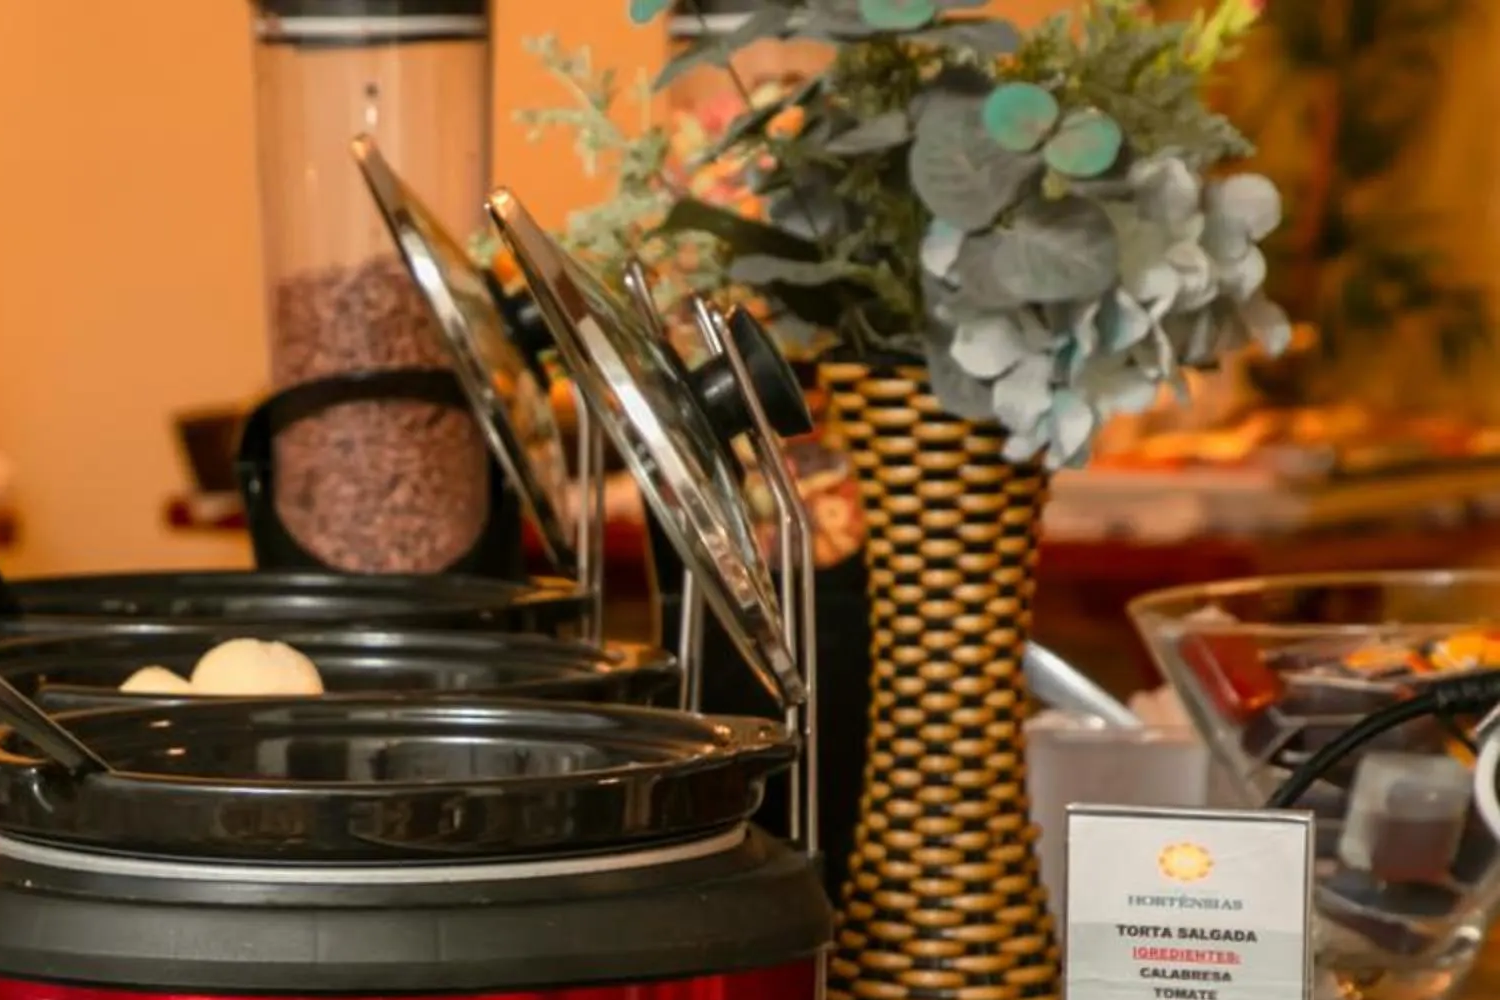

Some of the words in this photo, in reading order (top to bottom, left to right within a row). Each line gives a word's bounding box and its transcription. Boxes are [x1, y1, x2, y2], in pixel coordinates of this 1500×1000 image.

[1116, 924, 1172, 939] TORTA
[1177, 927, 1258, 942] SALGADA
[1140, 967, 1232, 982] CALABRESA
[1154, 987, 1218, 1000] TOMATE
